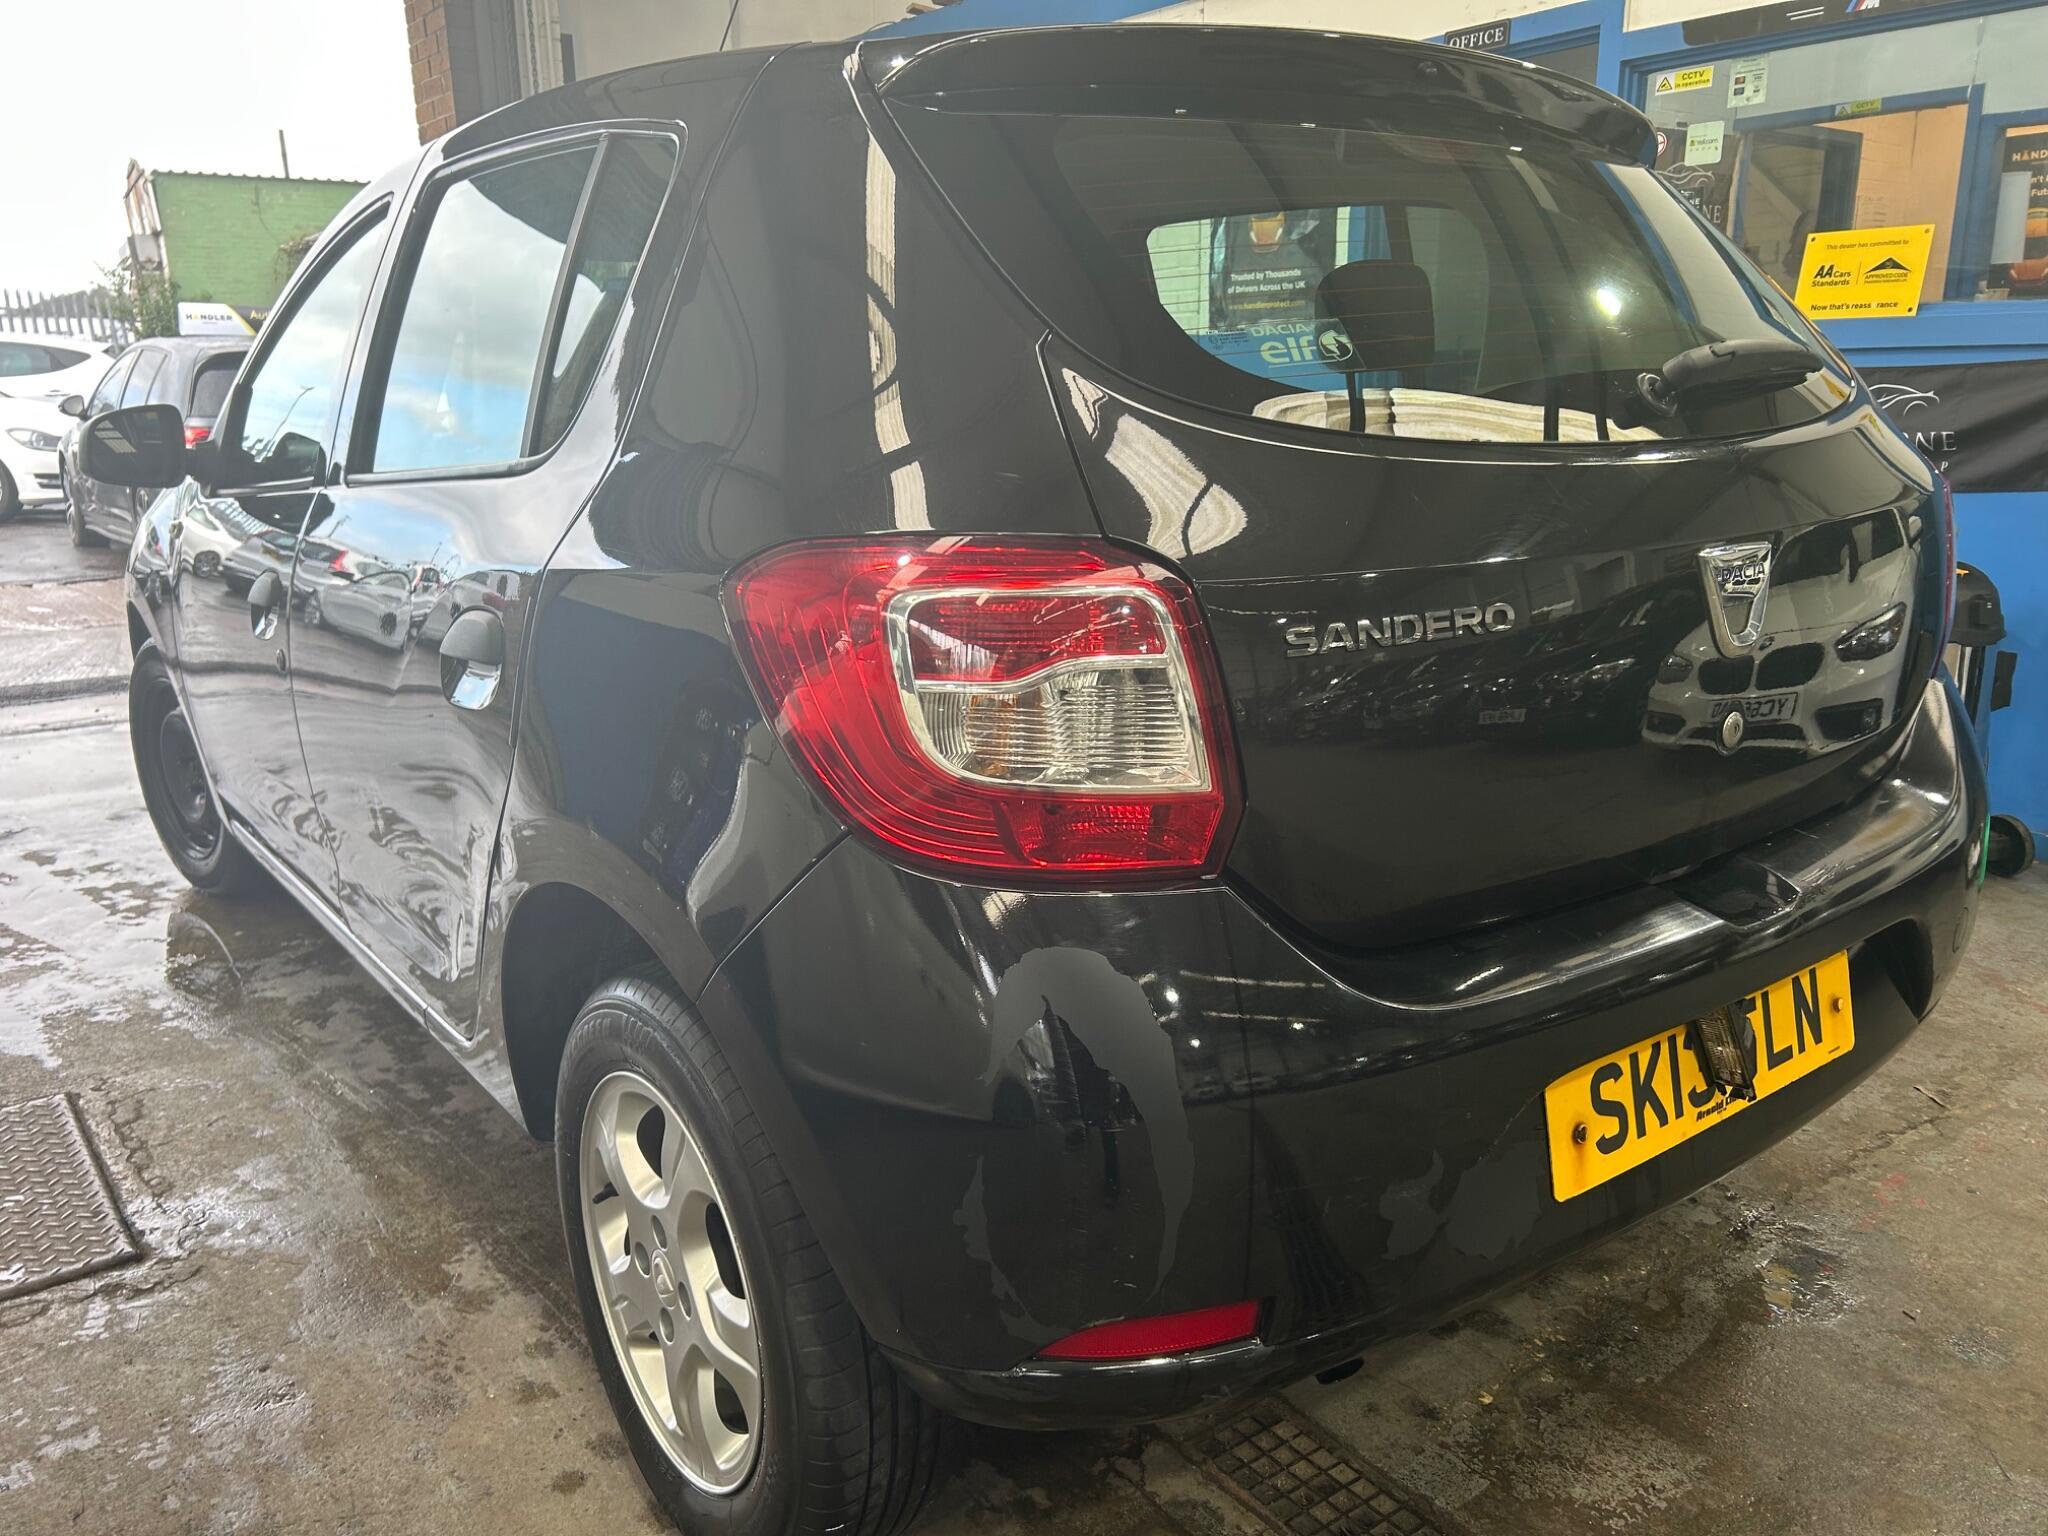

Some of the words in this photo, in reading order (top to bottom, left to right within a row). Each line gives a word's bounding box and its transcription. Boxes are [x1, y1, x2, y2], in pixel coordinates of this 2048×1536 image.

[1449, 27, 1504, 48] OFFICE
[1682, 70, 1706, 81] CCTV
[1682, 78, 1711, 87] operation
[1869, 239, 1901, 248] committed
[1231, 272, 1254, 281] Trusted
[1256, 272, 1264, 280] by
[1265, 269, 1301, 279] Thousands
[1814, 264, 1835, 279] AA
[1833, 270, 1851, 278] Cars
[1260, 284, 1281, 292] Across
[1282, 282, 1293, 290] the
[1295, 281, 1306, 289] UK
[1811, 279, 1850, 287] Standards
[1829, 302, 1850, 310] that's
[1250, 324, 1309, 337] DACIA
[1260, 335, 1316, 364] elf
[1721, 562, 1765, 583] DACIA
[1285, 602, 1516, 657] SANDERO
